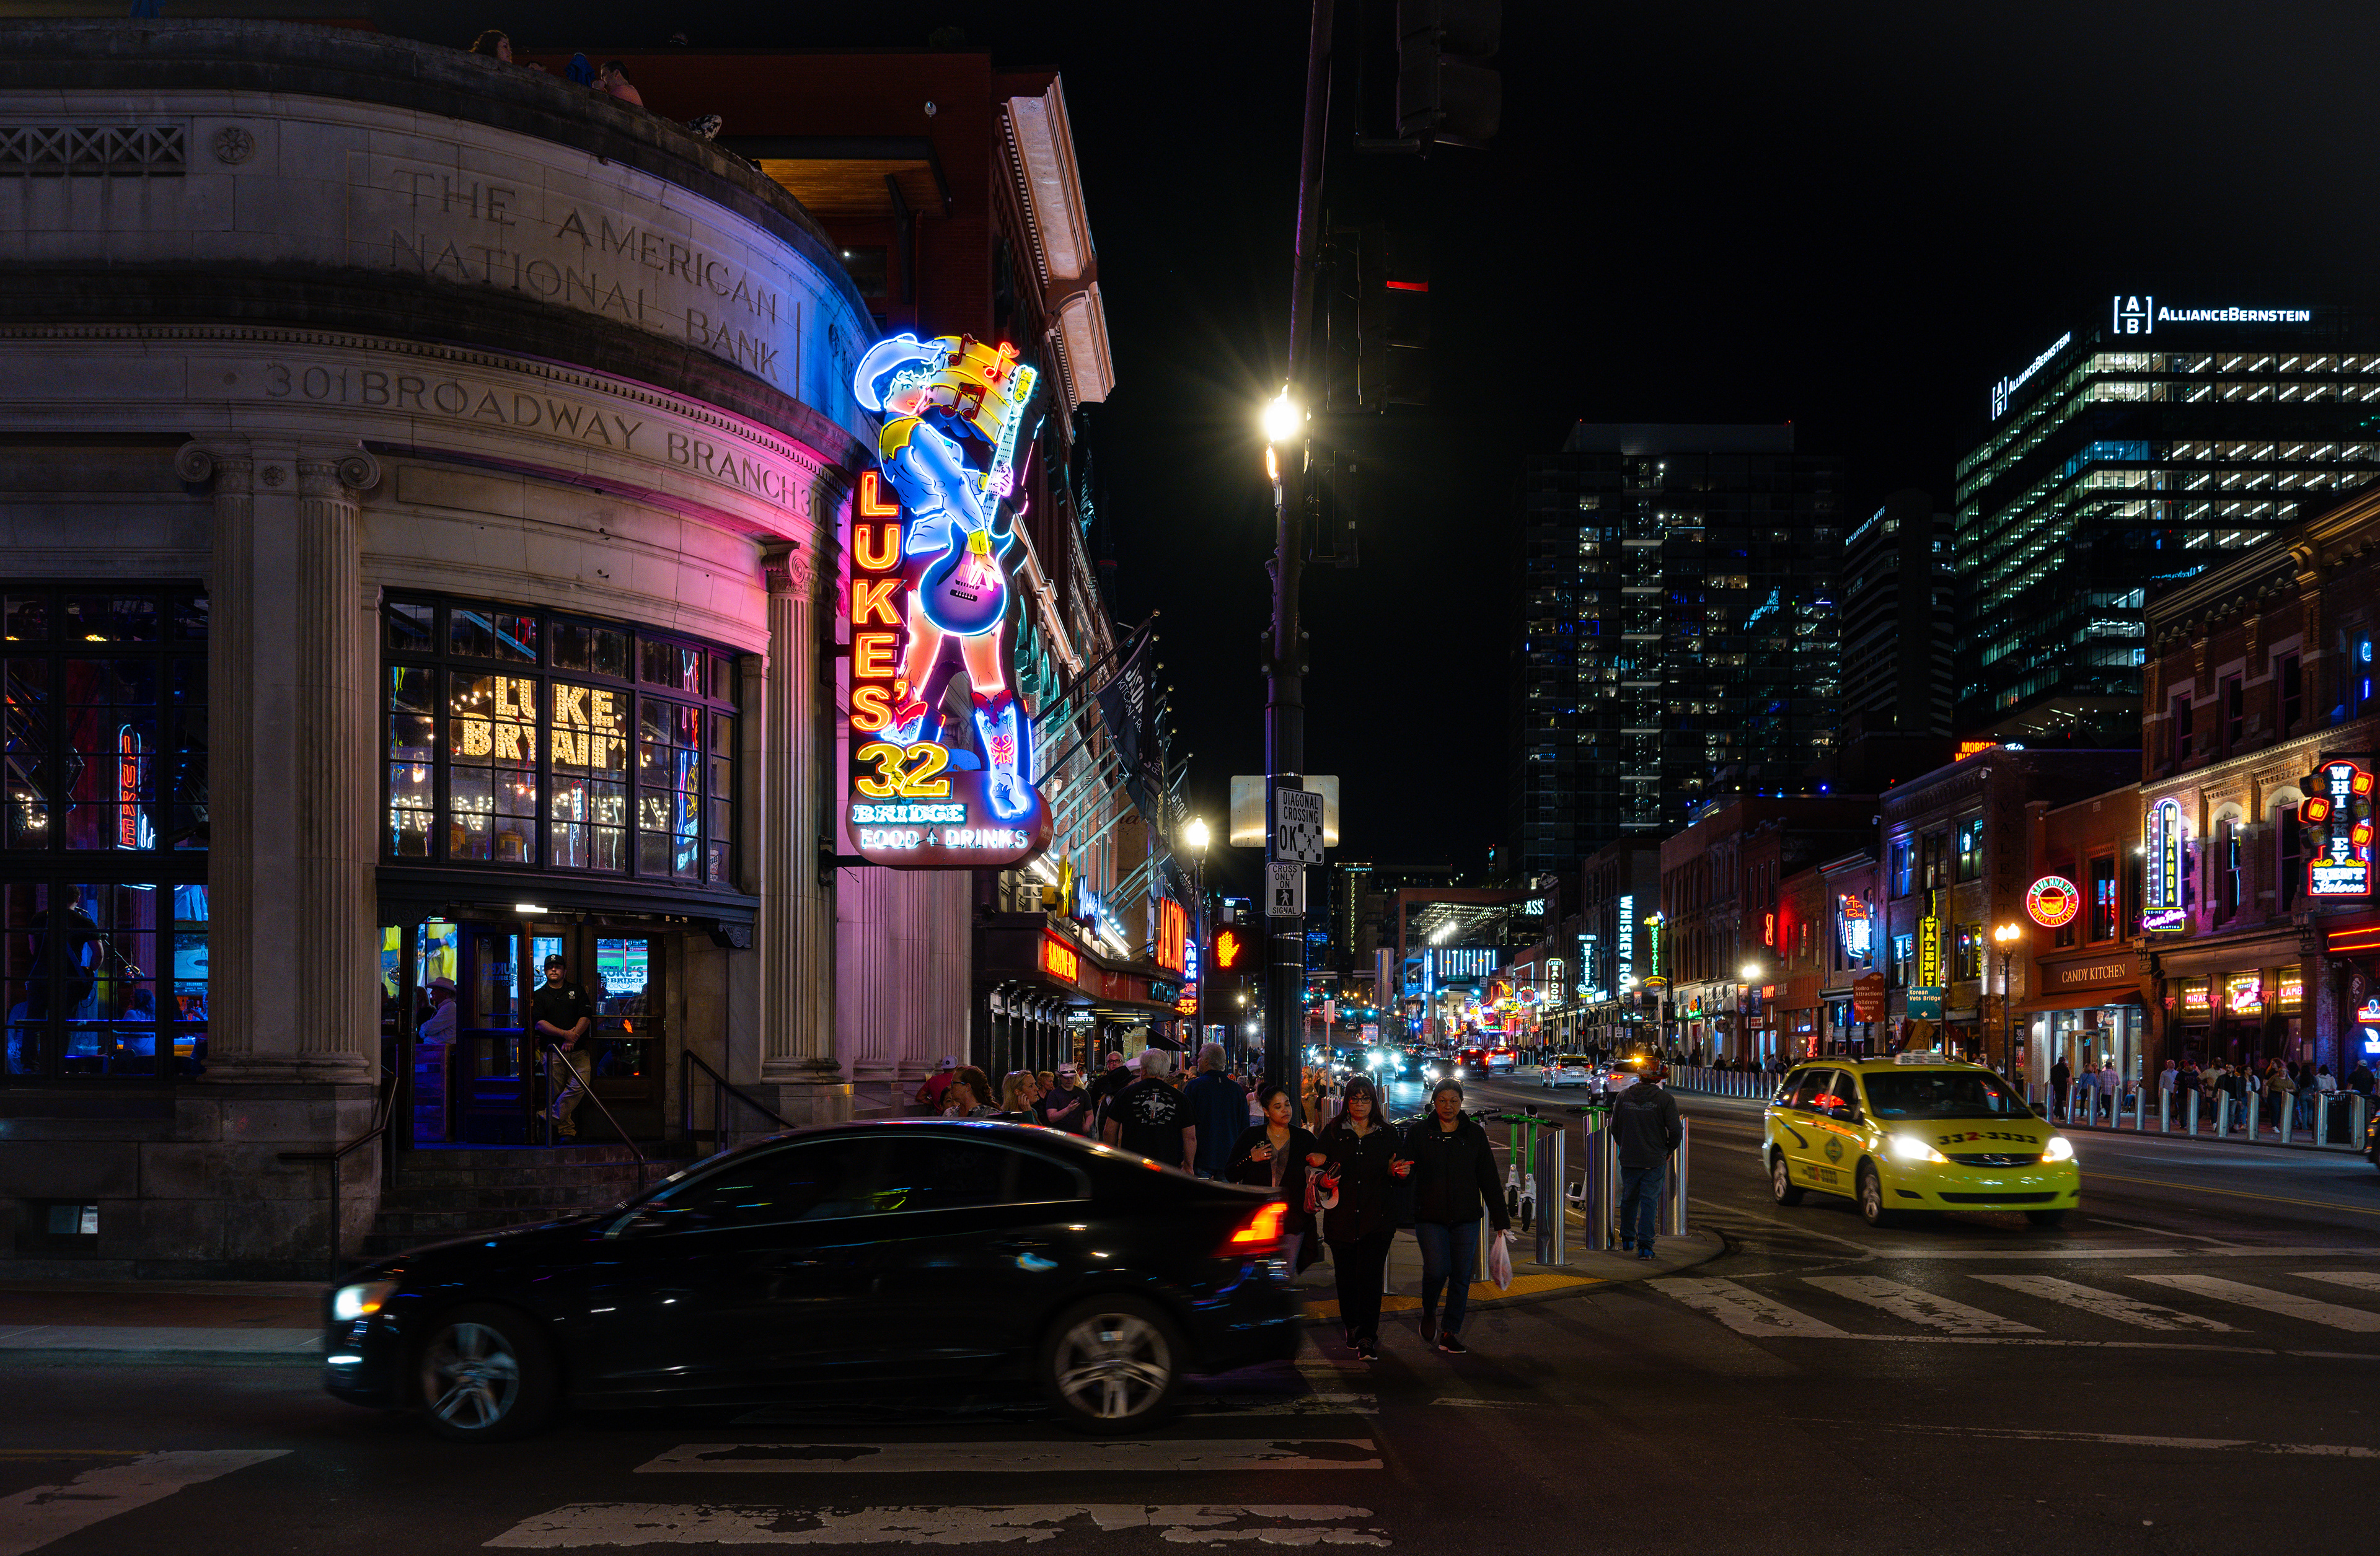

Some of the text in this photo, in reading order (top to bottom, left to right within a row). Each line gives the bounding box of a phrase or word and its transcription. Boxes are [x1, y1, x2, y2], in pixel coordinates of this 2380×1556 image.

[391, 167, 777, 325] THE AMERICAN
[390, 228, 778, 382] NATIONAL BANK
[2158, 307, 2310, 322] ALLIANCEBERNSTEIN
[2008, 332, 2070, 395] ALLIANCEBERNSTEIN
[265, 363, 348, 403] 301
[361, 370, 644, 451] BROADWAY
[667, 432, 797, 511] BRANCH
[850, 470, 915, 732] LUKE'S
[496, 676, 615, 727] LUKE
[855, 742, 954, 799] 32
[123, 736, 136, 846] LUKE
[2312, 778, 2325, 792] WB
[2355, 777, 2368, 791] WB
[1283, 792, 1318, 810] DIAGONAL
[853, 804, 967, 825] BRIDGE
[1283, 806, 1318, 824] CROSSING
[2311, 804, 2325, 818] WB
[2330, 767, 2351, 865] WHISKEY
[860, 828, 920, 851] FOOD
[946, 829, 1029, 850] DRINKS
[1279, 824, 1297, 852] OK
[2355, 829, 2368, 843] WB
[2165, 807, 2176, 902] MIRANDA
[1272, 865, 1297, 873] CROSS
[1275, 873, 1294, 881] ONLY
[1279, 881, 1290, 889] ON
[1998, 802, 2011, 976] VALENTE
[2030, 877, 2075, 897] SAVANNAH'S
[2312, 880, 2366, 894] Saloon
[1272, 906, 1297, 915] SIGNAL
[1846, 900, 1864, 909] Tin
[1845, 908, 1867, 920] Roof
[2030, 903, 2076, 925] CANDY KITCHEN
[2143, 915, 2166, 928] Casa
[1619, 895, 1633, 996] WHISKEY ROW
[600, 965, 644, 978] LUKE'S
[2062, 964, 2126, 983] CANDY KITCHEN
[1152, 981, 1178, 1003] KITCHEN
[1578, 984, 1596, 995] Row
[1762, 985, 1775, 999] BOOT
[2280, 986, 2303, 997] LAMB
[1938, 1132, 2039, 1145] 332-3333
